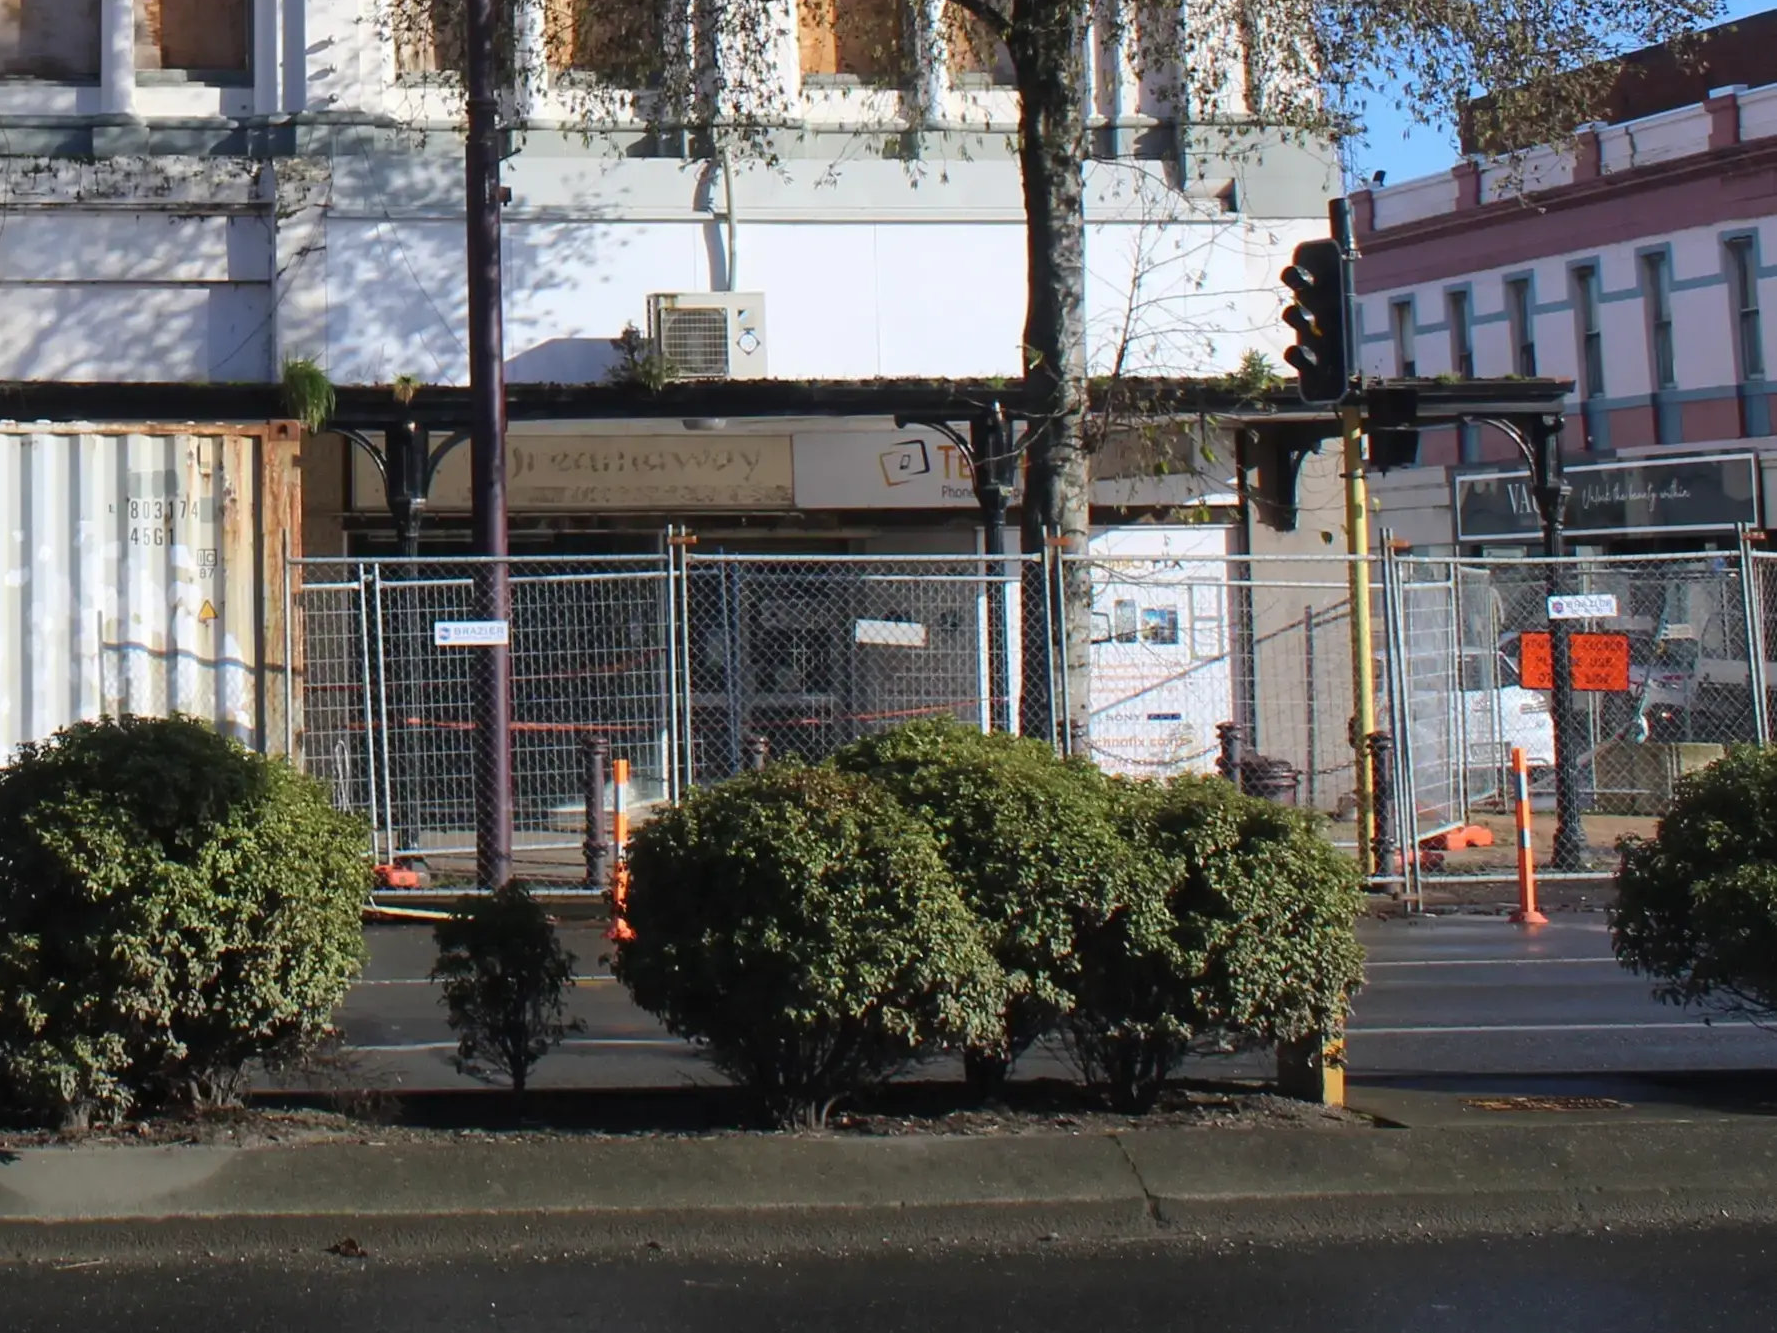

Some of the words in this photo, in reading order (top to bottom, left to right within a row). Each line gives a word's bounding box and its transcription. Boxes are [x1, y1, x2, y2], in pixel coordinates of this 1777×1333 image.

[130, 500, 199, 520] 803174
[130, 527, 175, 546] 45G1
[454, 627, 504, 636] BRAZIER
